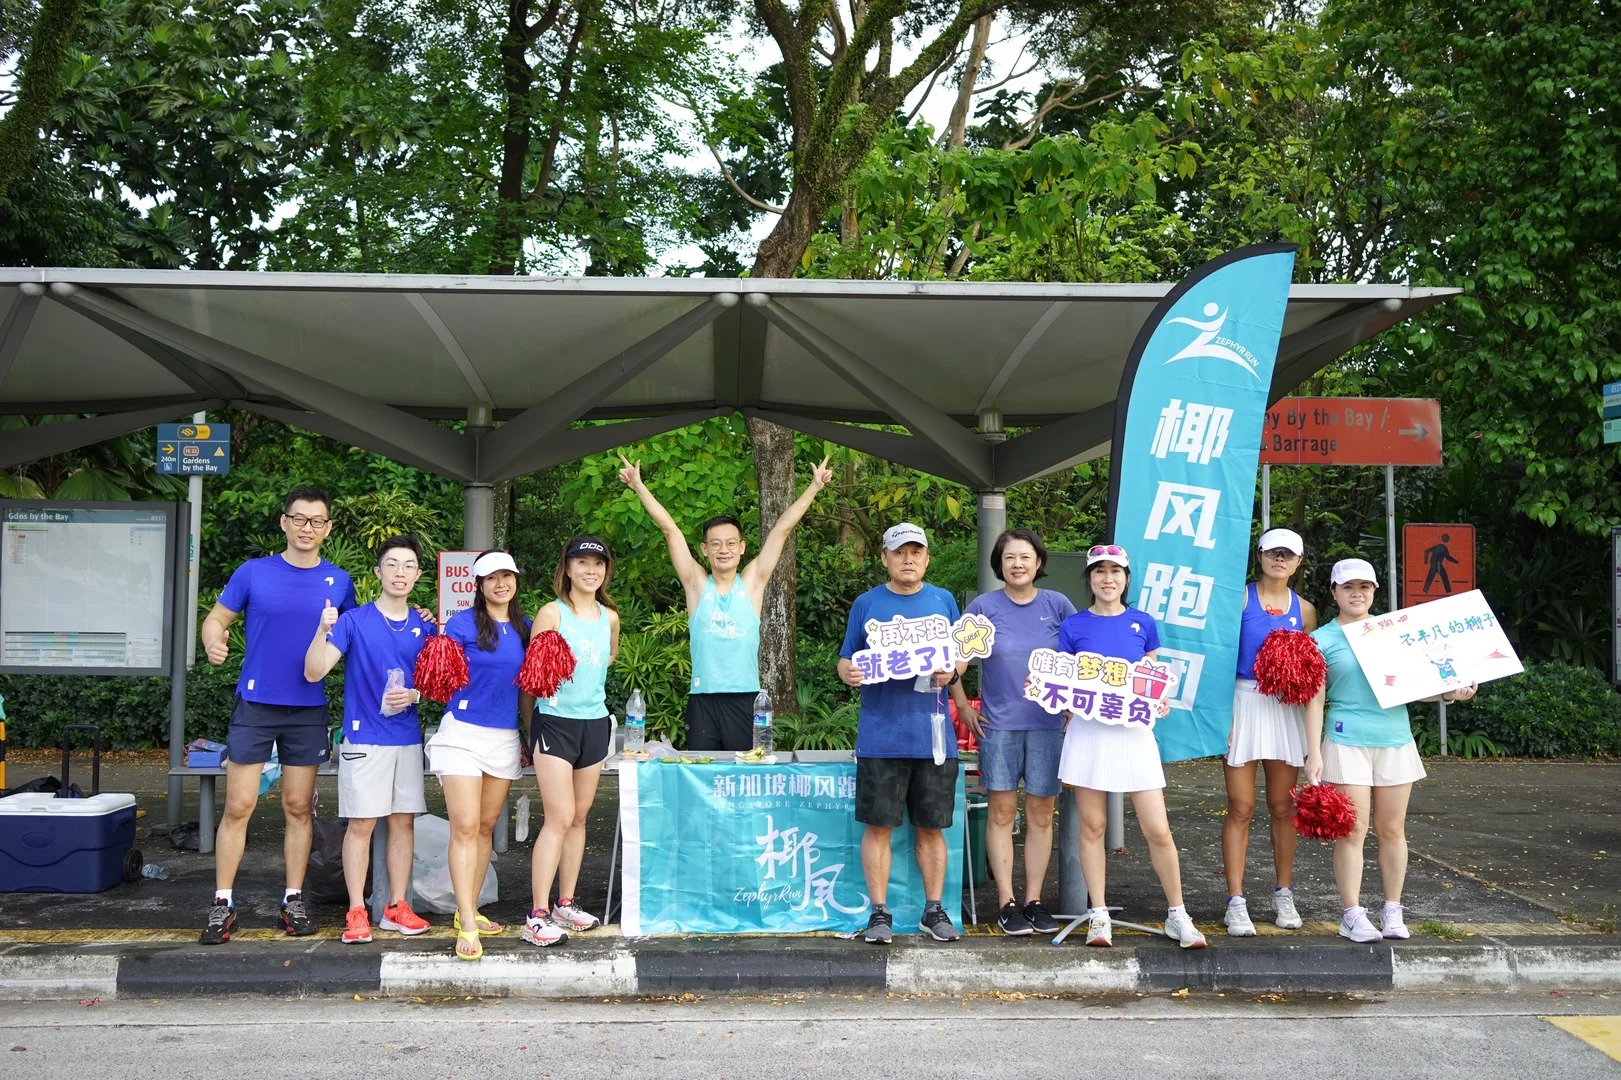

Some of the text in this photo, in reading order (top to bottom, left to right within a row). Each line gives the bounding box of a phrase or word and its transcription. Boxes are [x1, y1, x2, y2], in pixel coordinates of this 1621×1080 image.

[1215, 336, 1260, 368] ZEPHYR RUN
[1287, 408, 1307, 430] By
[1313, 407, 1339, 426] the
[1344, 408, 1373, 431] Bay
[1273, 434, 1338, 457] Barrage
[182, 456, 211, 465] Gardens
[182, 464, 191, 472] by
[205, 464, 218, 472] Bay
[8, 512, 69, 523] Gdns by the Bay
[445, 565, 470, 578] BUS
[879, 617, 949, 648] 再不跑
[963, 629, 981, 644] GREAT
[1399, 612, 1495, 646] 不平凡的椰子
[1032, 651, 1129, 688] 唯有梦想
[1041, 681, 1151, 726] 不可辜负
[712, 800, 851, 810] SINGAPORE ZEPHYR
